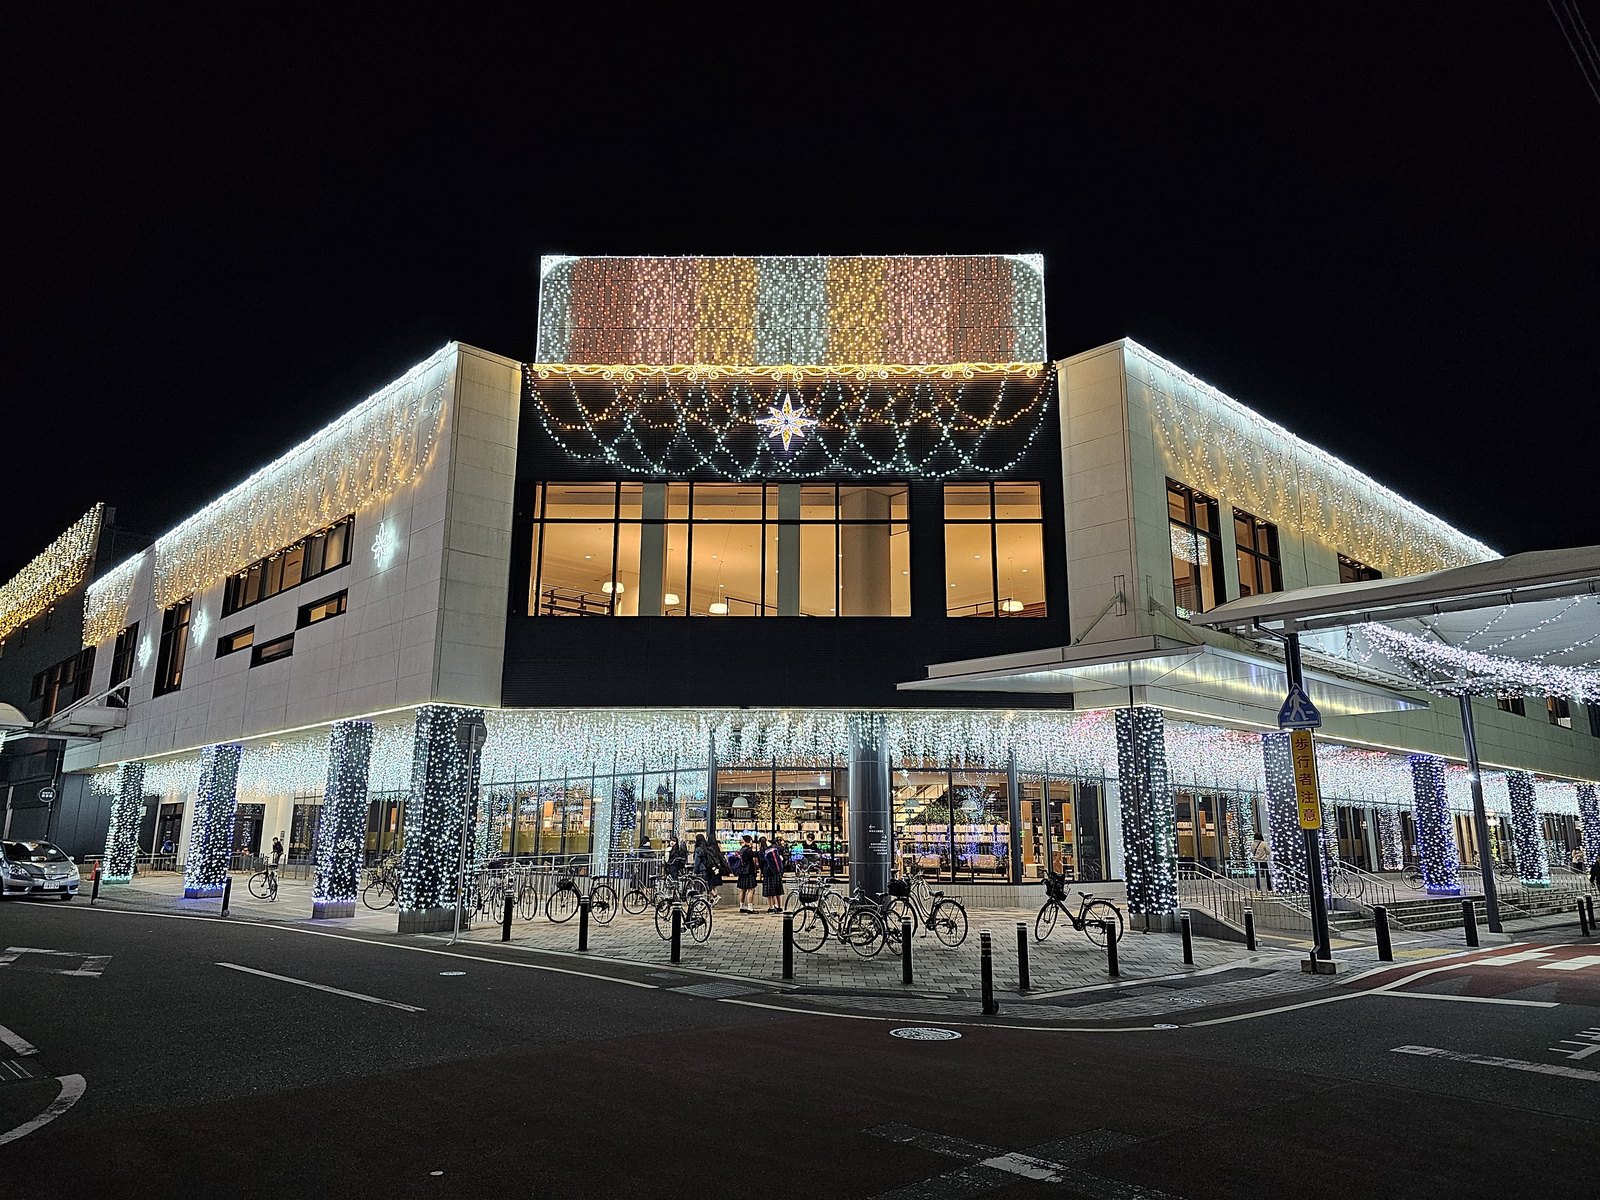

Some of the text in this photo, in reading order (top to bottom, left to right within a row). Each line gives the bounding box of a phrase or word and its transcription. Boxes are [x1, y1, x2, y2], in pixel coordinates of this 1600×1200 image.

[1295, 738, 1317, 822] 歩行者注意
